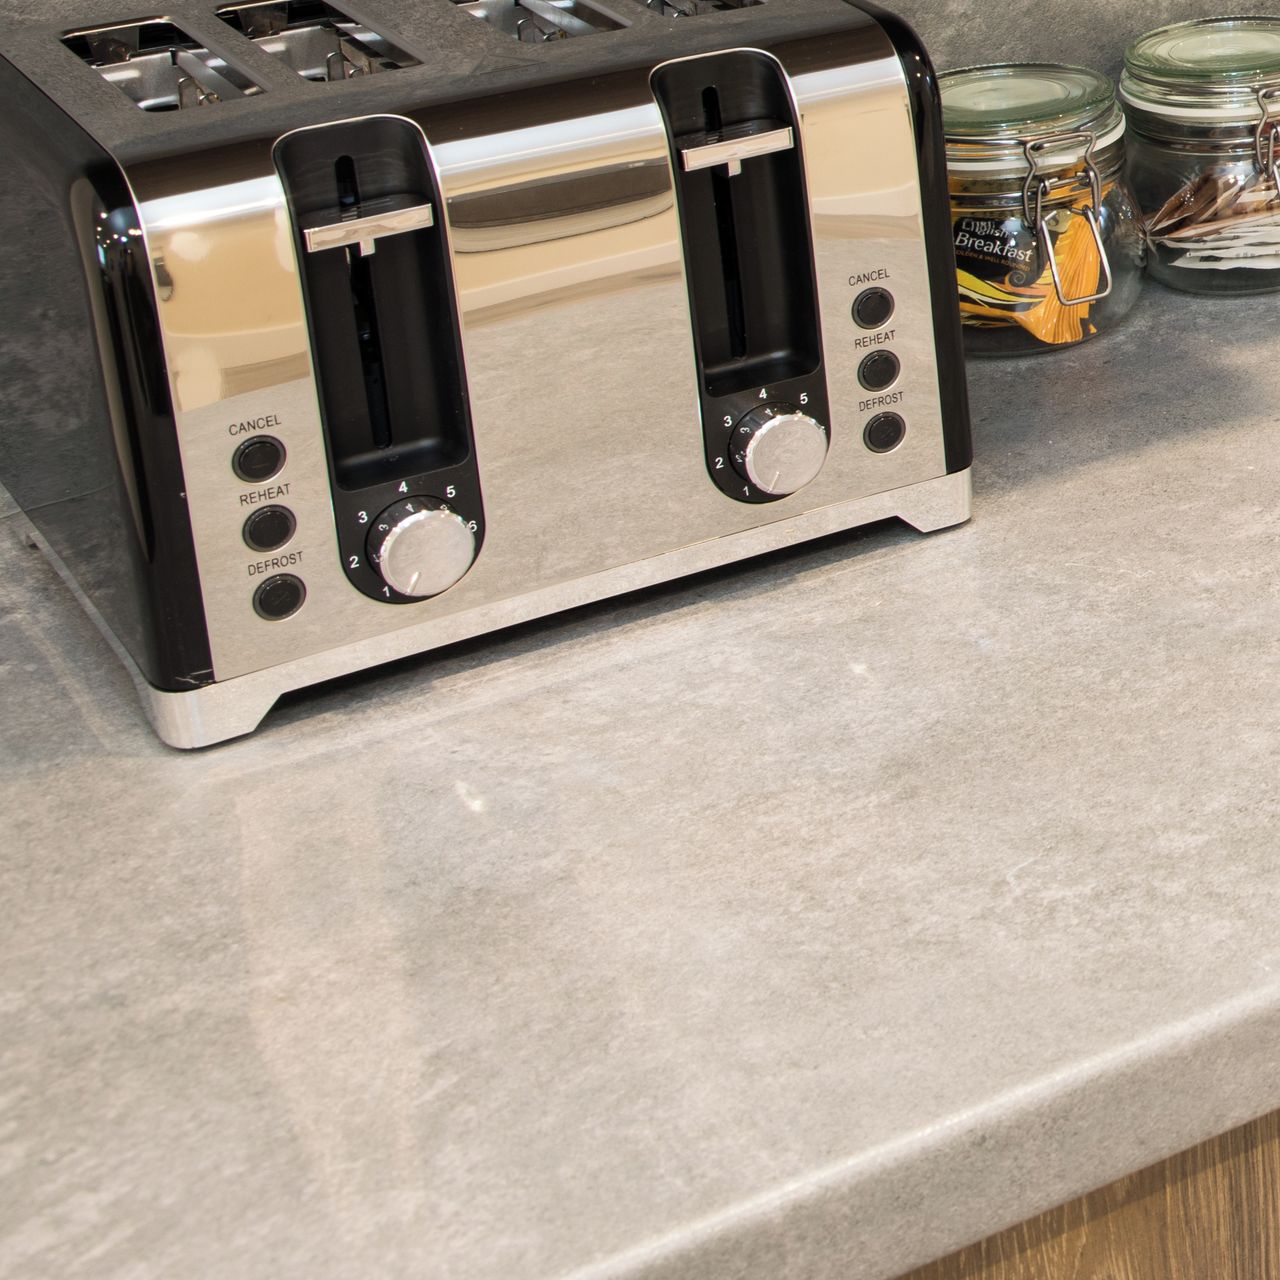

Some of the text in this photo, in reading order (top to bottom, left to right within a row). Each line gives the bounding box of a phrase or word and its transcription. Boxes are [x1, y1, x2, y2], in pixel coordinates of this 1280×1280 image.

[955, 232, 1033, 263] Breakfast
[848, 268, 890, 287] CANCEL
[854, 330, 896, 349] REHEAT
[759, 388, 767, 399] 4
[800, 392, 808, 404] 5
[858, 391, 904, 412] DEFROST
[228, 414, 282, 437] CANCEL
[723, 415, 732, 427] 3
[715, 457, 724, 469] 2
[398, 481, 408, 493] 4
[446, 485, 456, 498] 5
[743, 486, 749, 496] 1
[239, 483, 291, 506] REHEAT
[358, 511, 368, 523] 3
[467, 520, 478, 532] 6
[247, 551, 304, 576] DEFROST
[349, 555, 360, 568] 2
[382, 586, 390, 597] 1
